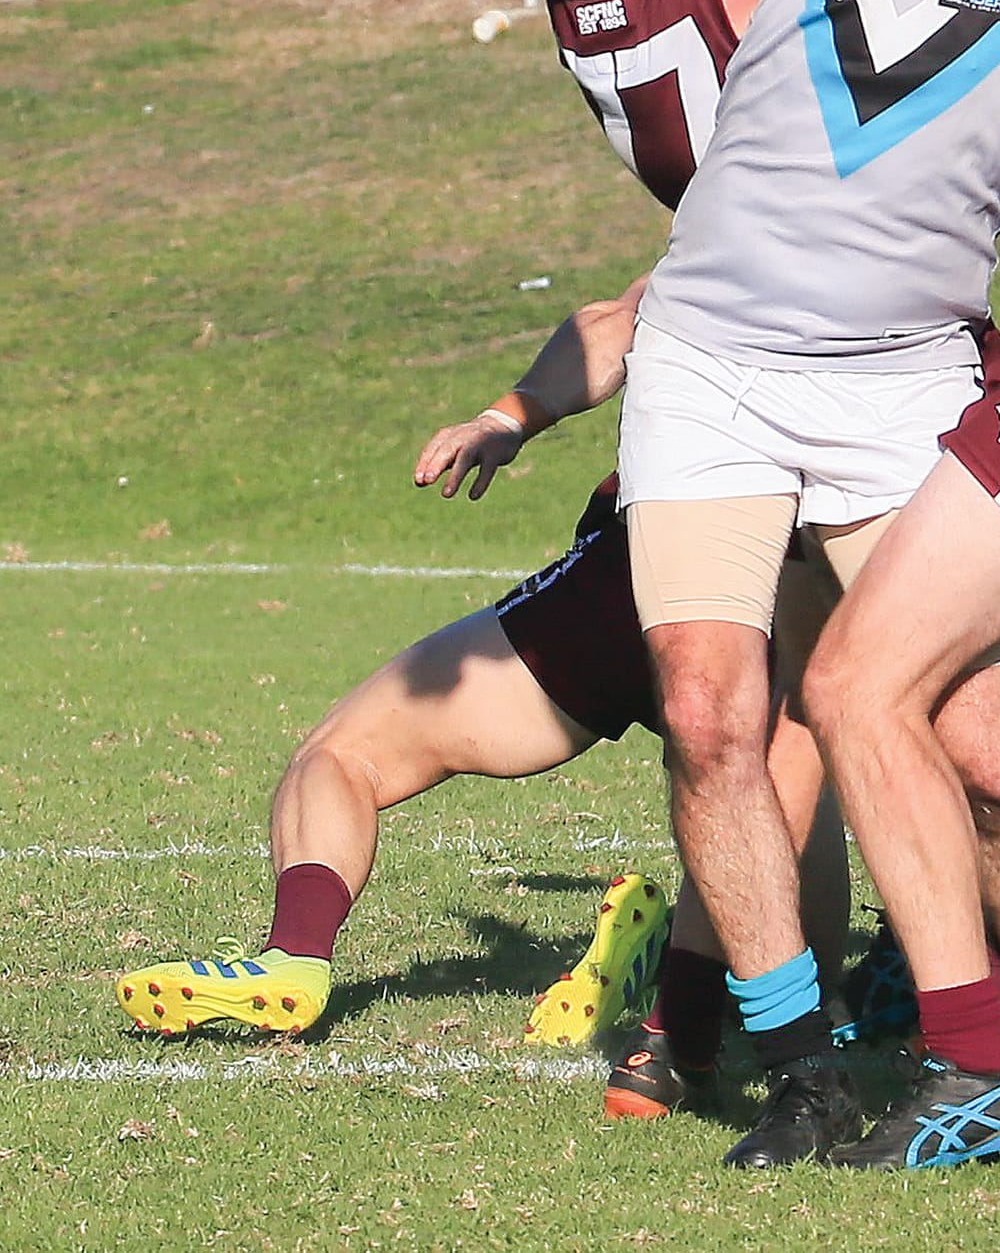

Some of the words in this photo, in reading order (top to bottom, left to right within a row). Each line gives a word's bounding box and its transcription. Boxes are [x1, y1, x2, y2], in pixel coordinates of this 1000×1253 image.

[576, 0, 625, 23] SCFNC
[579, 21, 598, 35] EST
[599, 14, 628, 31] 1894
